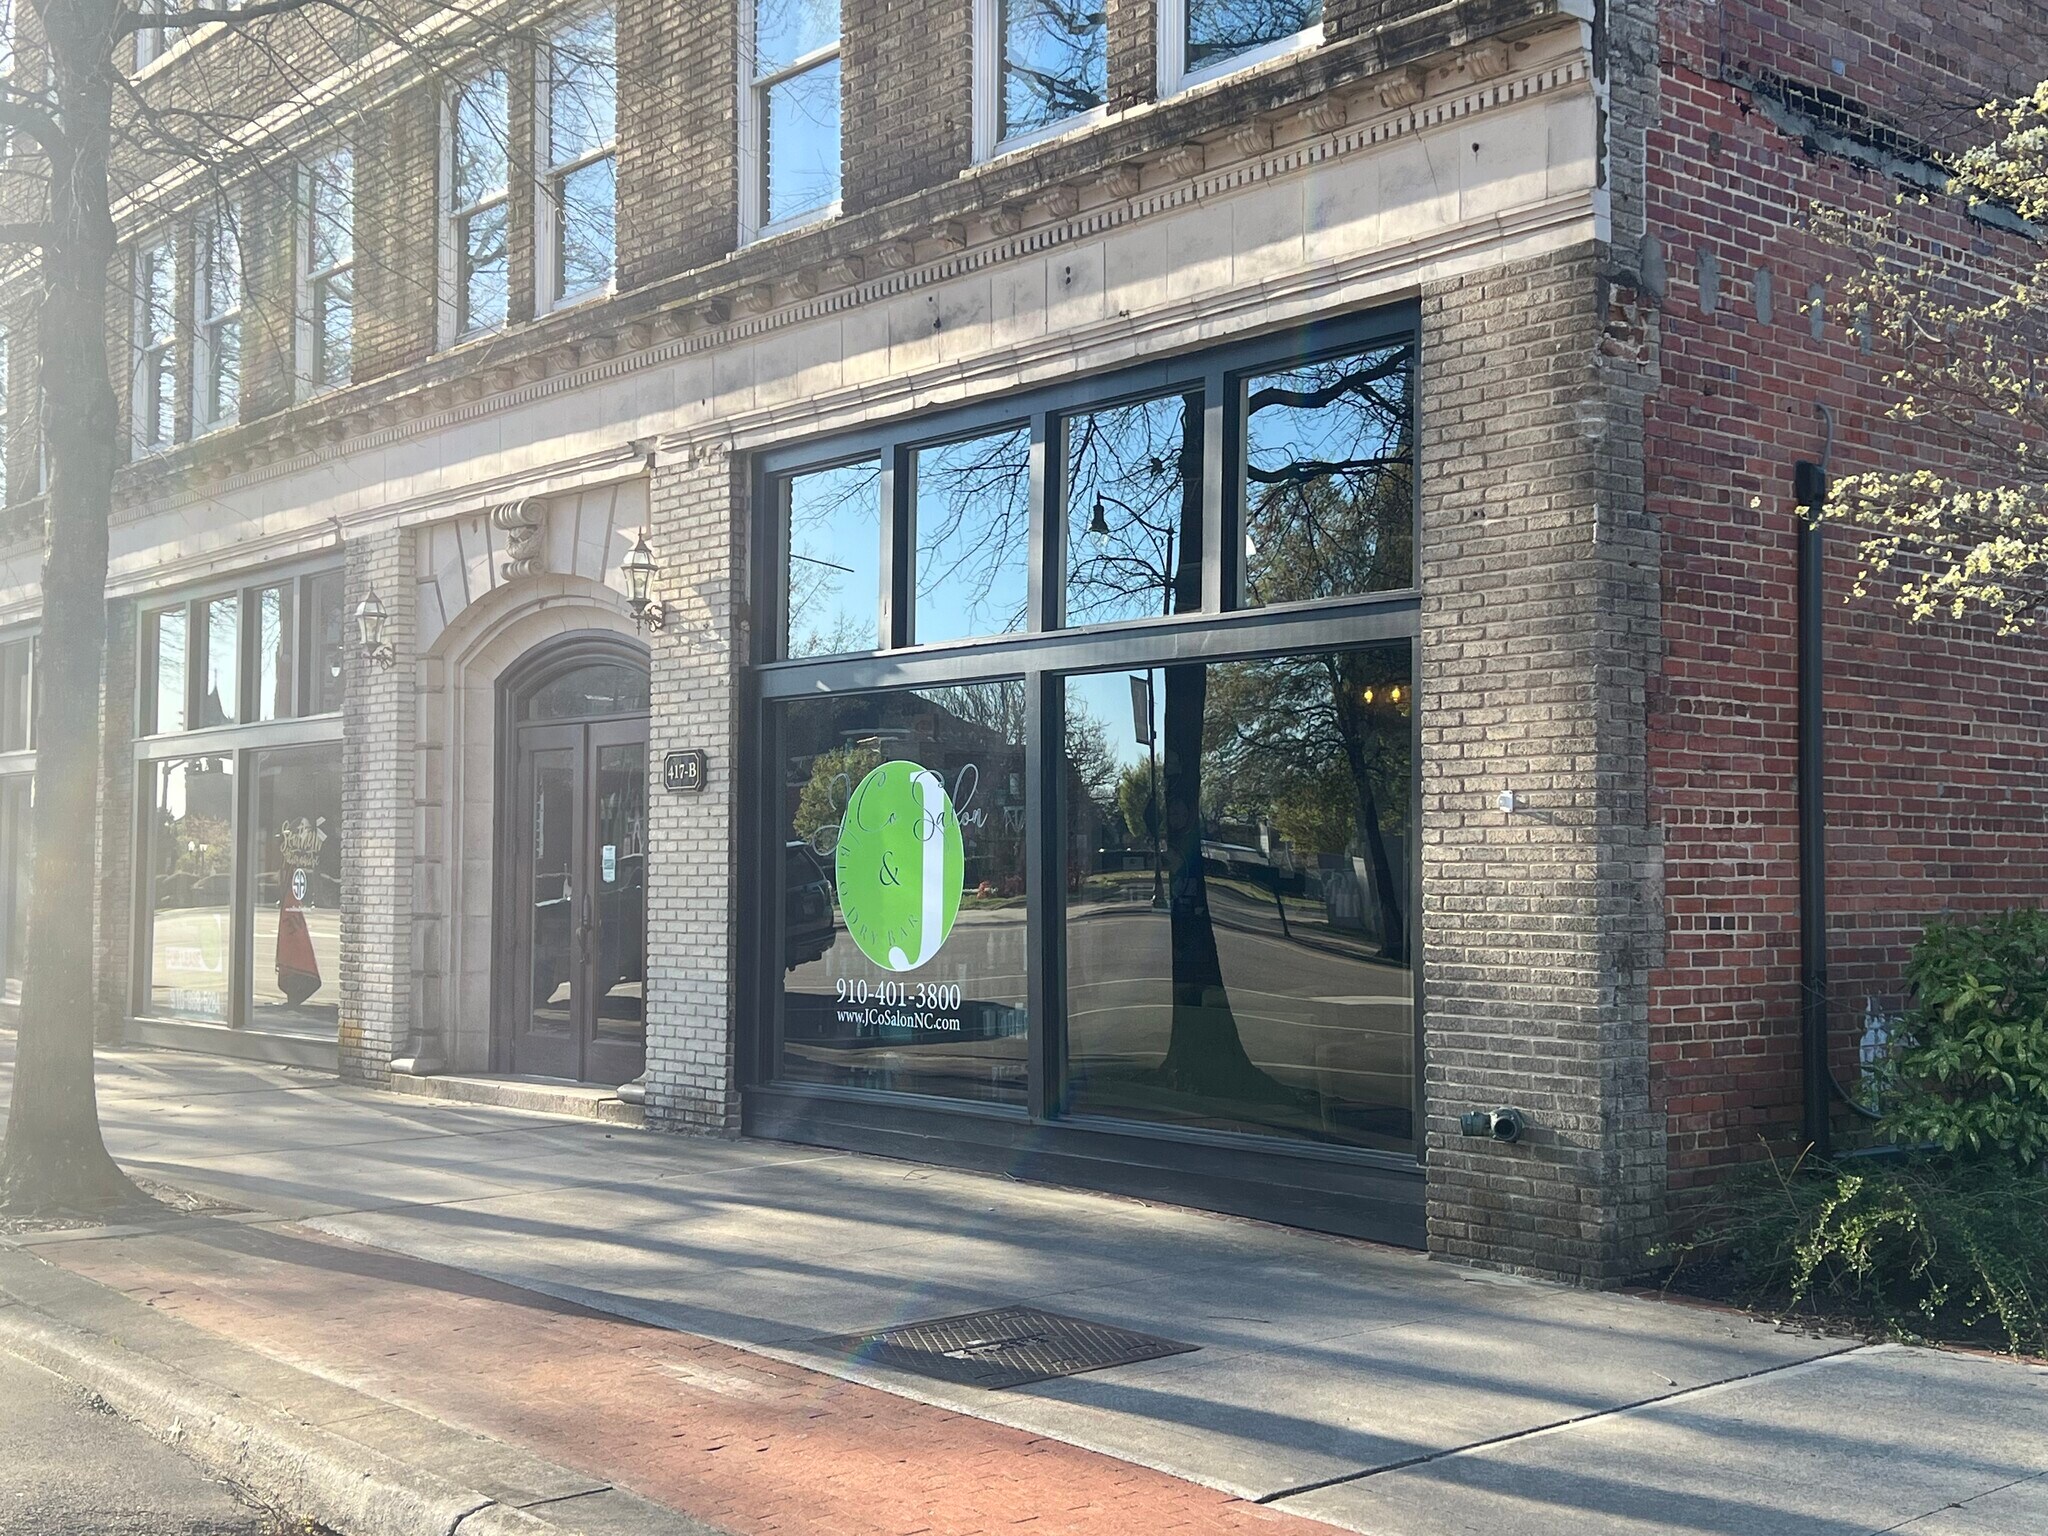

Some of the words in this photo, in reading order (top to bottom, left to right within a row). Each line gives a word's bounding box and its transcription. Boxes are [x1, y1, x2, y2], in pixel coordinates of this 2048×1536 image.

[668, 761, 697, 780] 417-B
[911, 763, 988, 841] Salon
[879, 851, 901, 886] &
[847, 906, 878, 945] DRY
[836, 978, 961, 1011] 910-401-3800
[836, 1008, 961, 1031] www.JCoSalonNC.com
